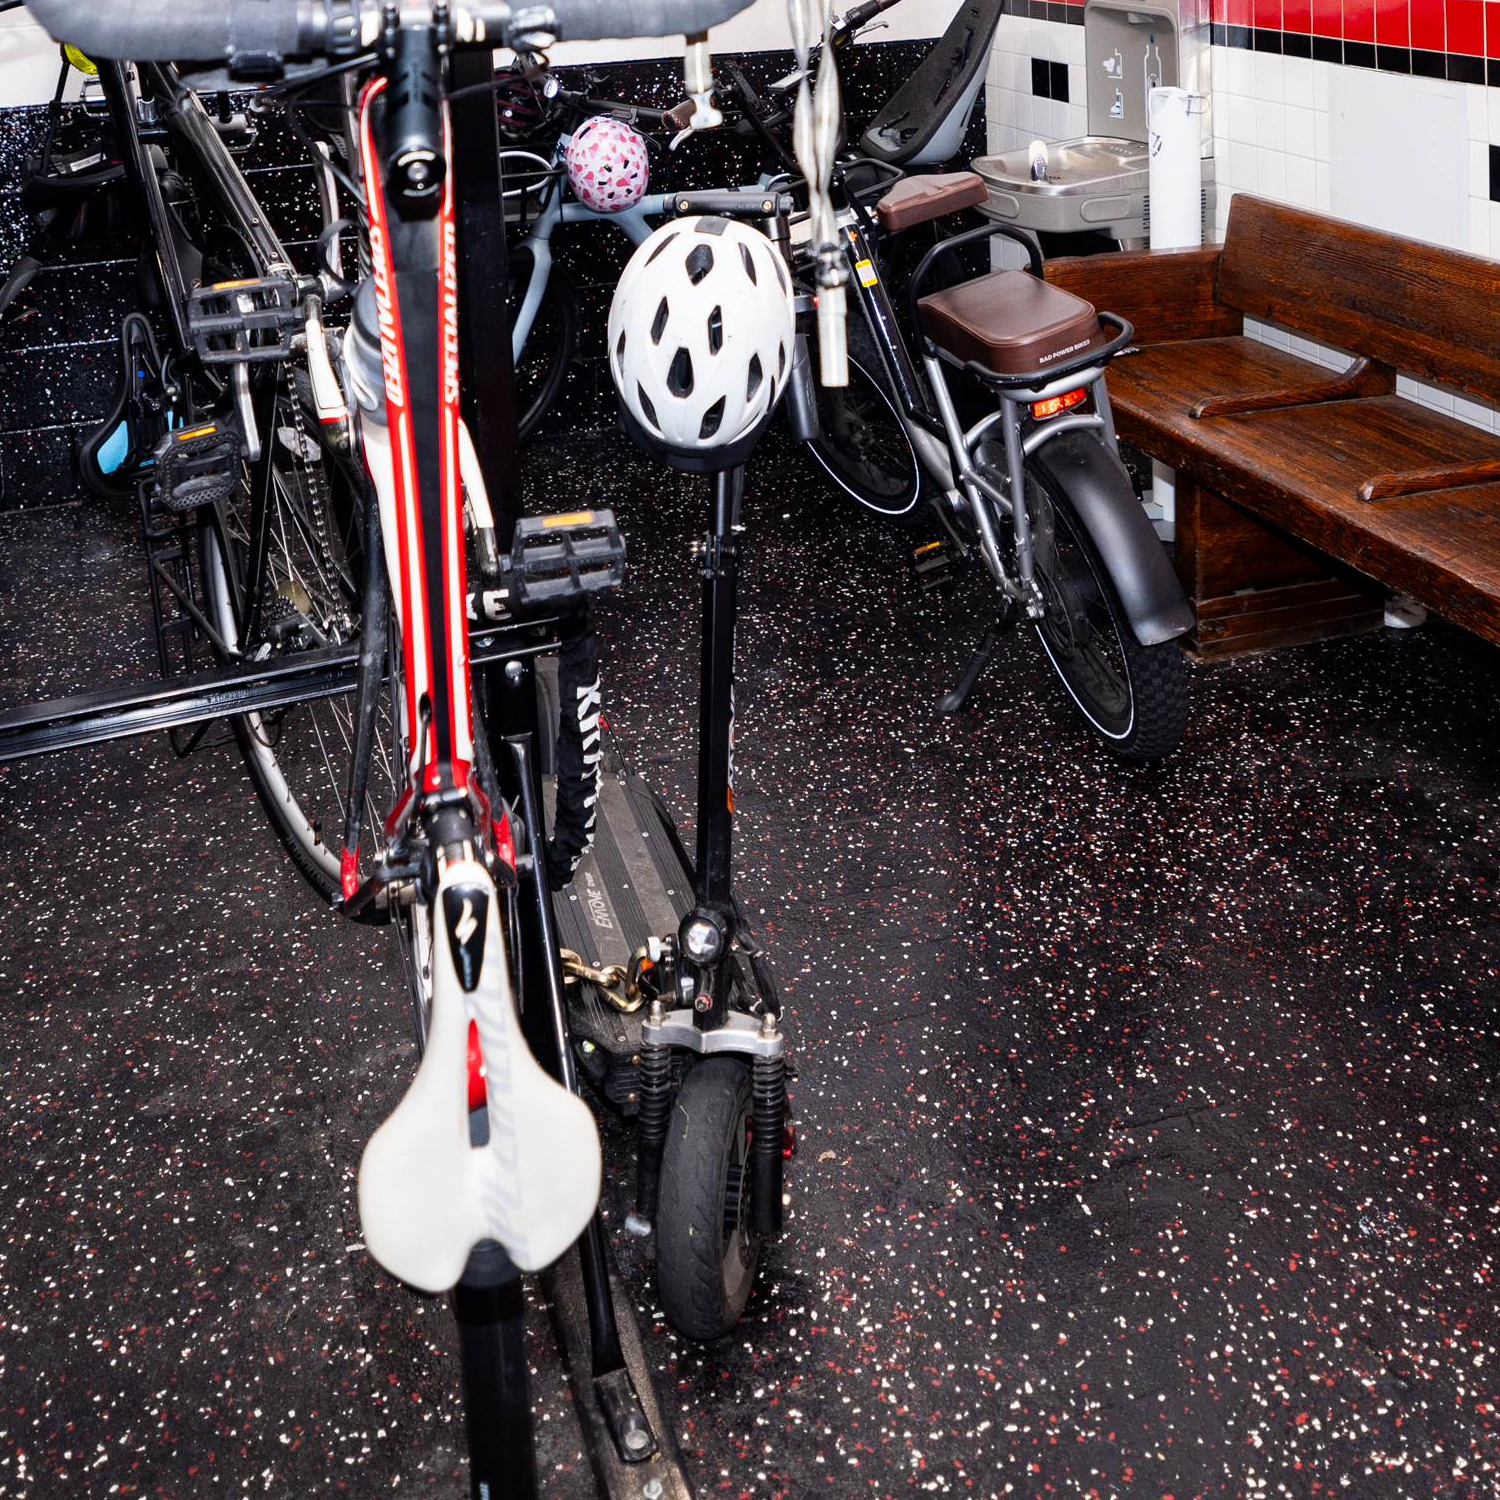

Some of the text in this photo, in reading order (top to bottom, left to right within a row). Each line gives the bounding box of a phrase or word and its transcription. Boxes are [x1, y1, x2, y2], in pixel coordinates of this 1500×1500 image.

[368, 225, 404, 408] SPECIALIZED
[443, 221, 460, 406] SPECIALIZED
[1039, 338, 1091, 364] RAD POWER BIKES
[285, 834, 333, 894] BONTRAGER
[586, 888, 614, 929] EMOVE
